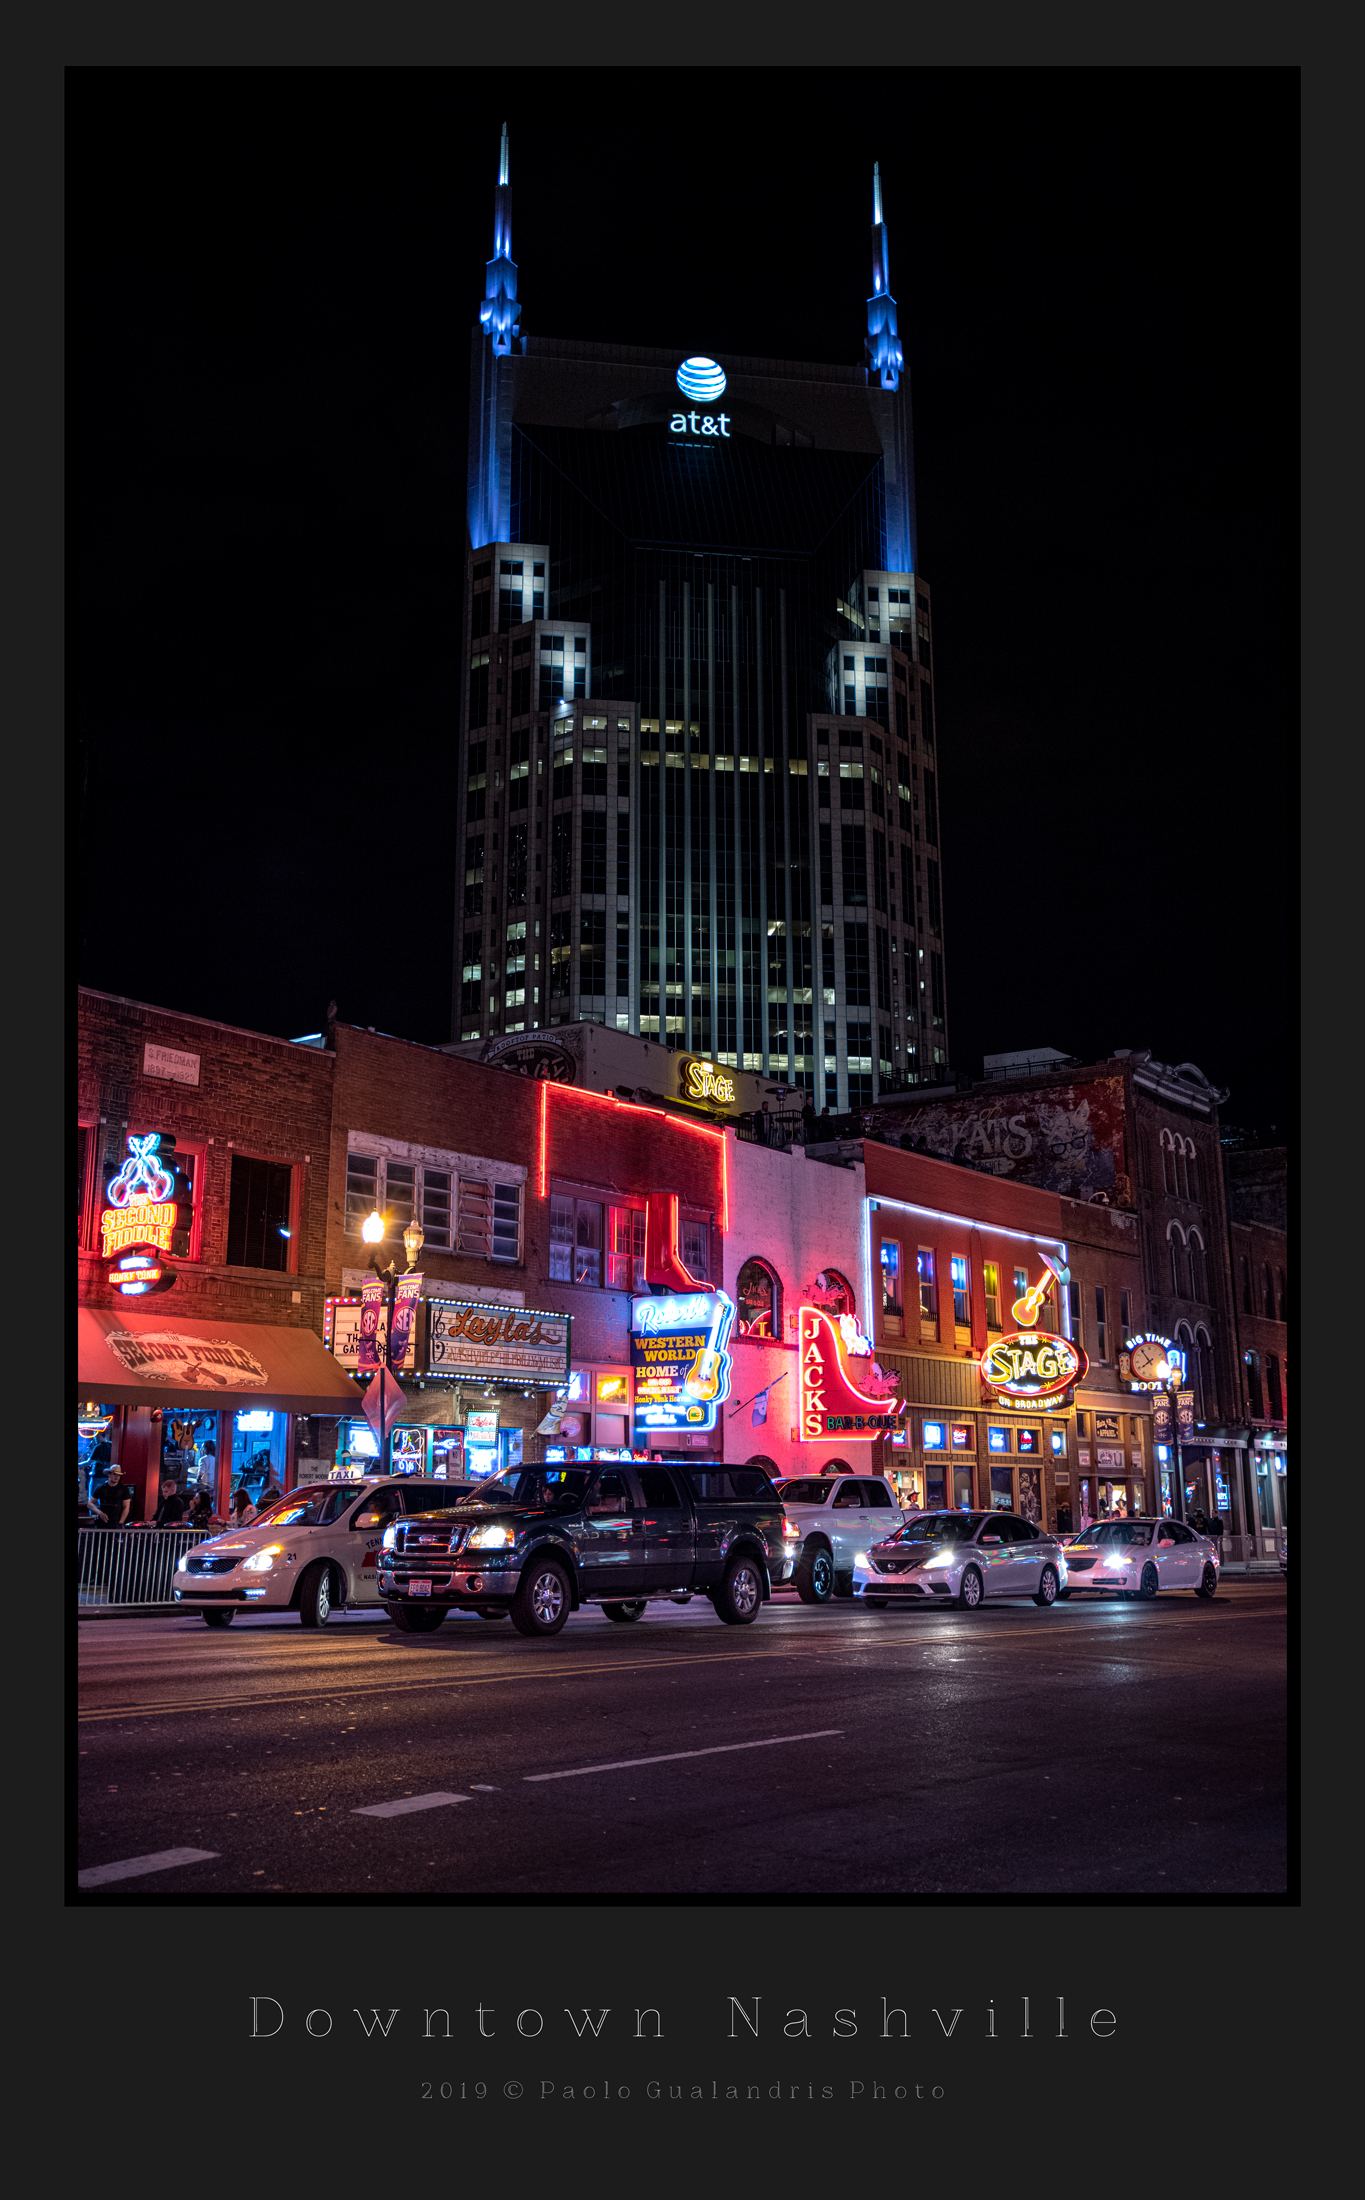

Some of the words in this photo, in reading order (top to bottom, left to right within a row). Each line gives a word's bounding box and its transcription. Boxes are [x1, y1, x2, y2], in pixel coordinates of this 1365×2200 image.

[670, 411, 732, 437] at&t
[496, 1035, 530, 1051] ROOFTOP
[533, 1034, 556, 1043] PATIO
[517, 1049, 535, 1061] THE
[689, 1063, 735, 1101] STAGE
[101, 1203, 174, 1234] SECOND
[102, 1225, 169, 1258] FIDDLE
[362, 1293, 381, 1302] FANS
[398, 1290, 420, 1299] FANS
[363, 1311, 376, 1334] SEC
[449, 1307, 562, 1349] Layla's
[635, 1335, 706, 1350] WESTERN
[1018, 1335, 1038, 1346] THE
[1126, 1335, 1144, 1350] BIG
[1145, 1333, 1172, 1348] TIME
[112, 1339, 188, 1369] SECOND
[186, 1345, 264, 1376] FIDDLE
[451, 1349, 495, 1364] NASHVILLE
[538, 1354, 563, 1369] MUSIC
[644, 1349, 696, 1362] WORLD
[636, 1366, 678, 1378] HOME
[680, 1364, 689, 1379] of
[987, 1344, 1075, 1384] STAGE
[803, 1317, 829, 1436] JACKS
[998, 1396, 1012, 1406] ON
[1015, 1394, 1064, 1409] BROADWAY
[827, 1415, 897, 1430] BAR-B-QUE
[1156, 1411, 1169, 1425] SEC
[1180, 1410, 1193, 1424] SEC
[330, 1471, 354, 1479] TAXI
